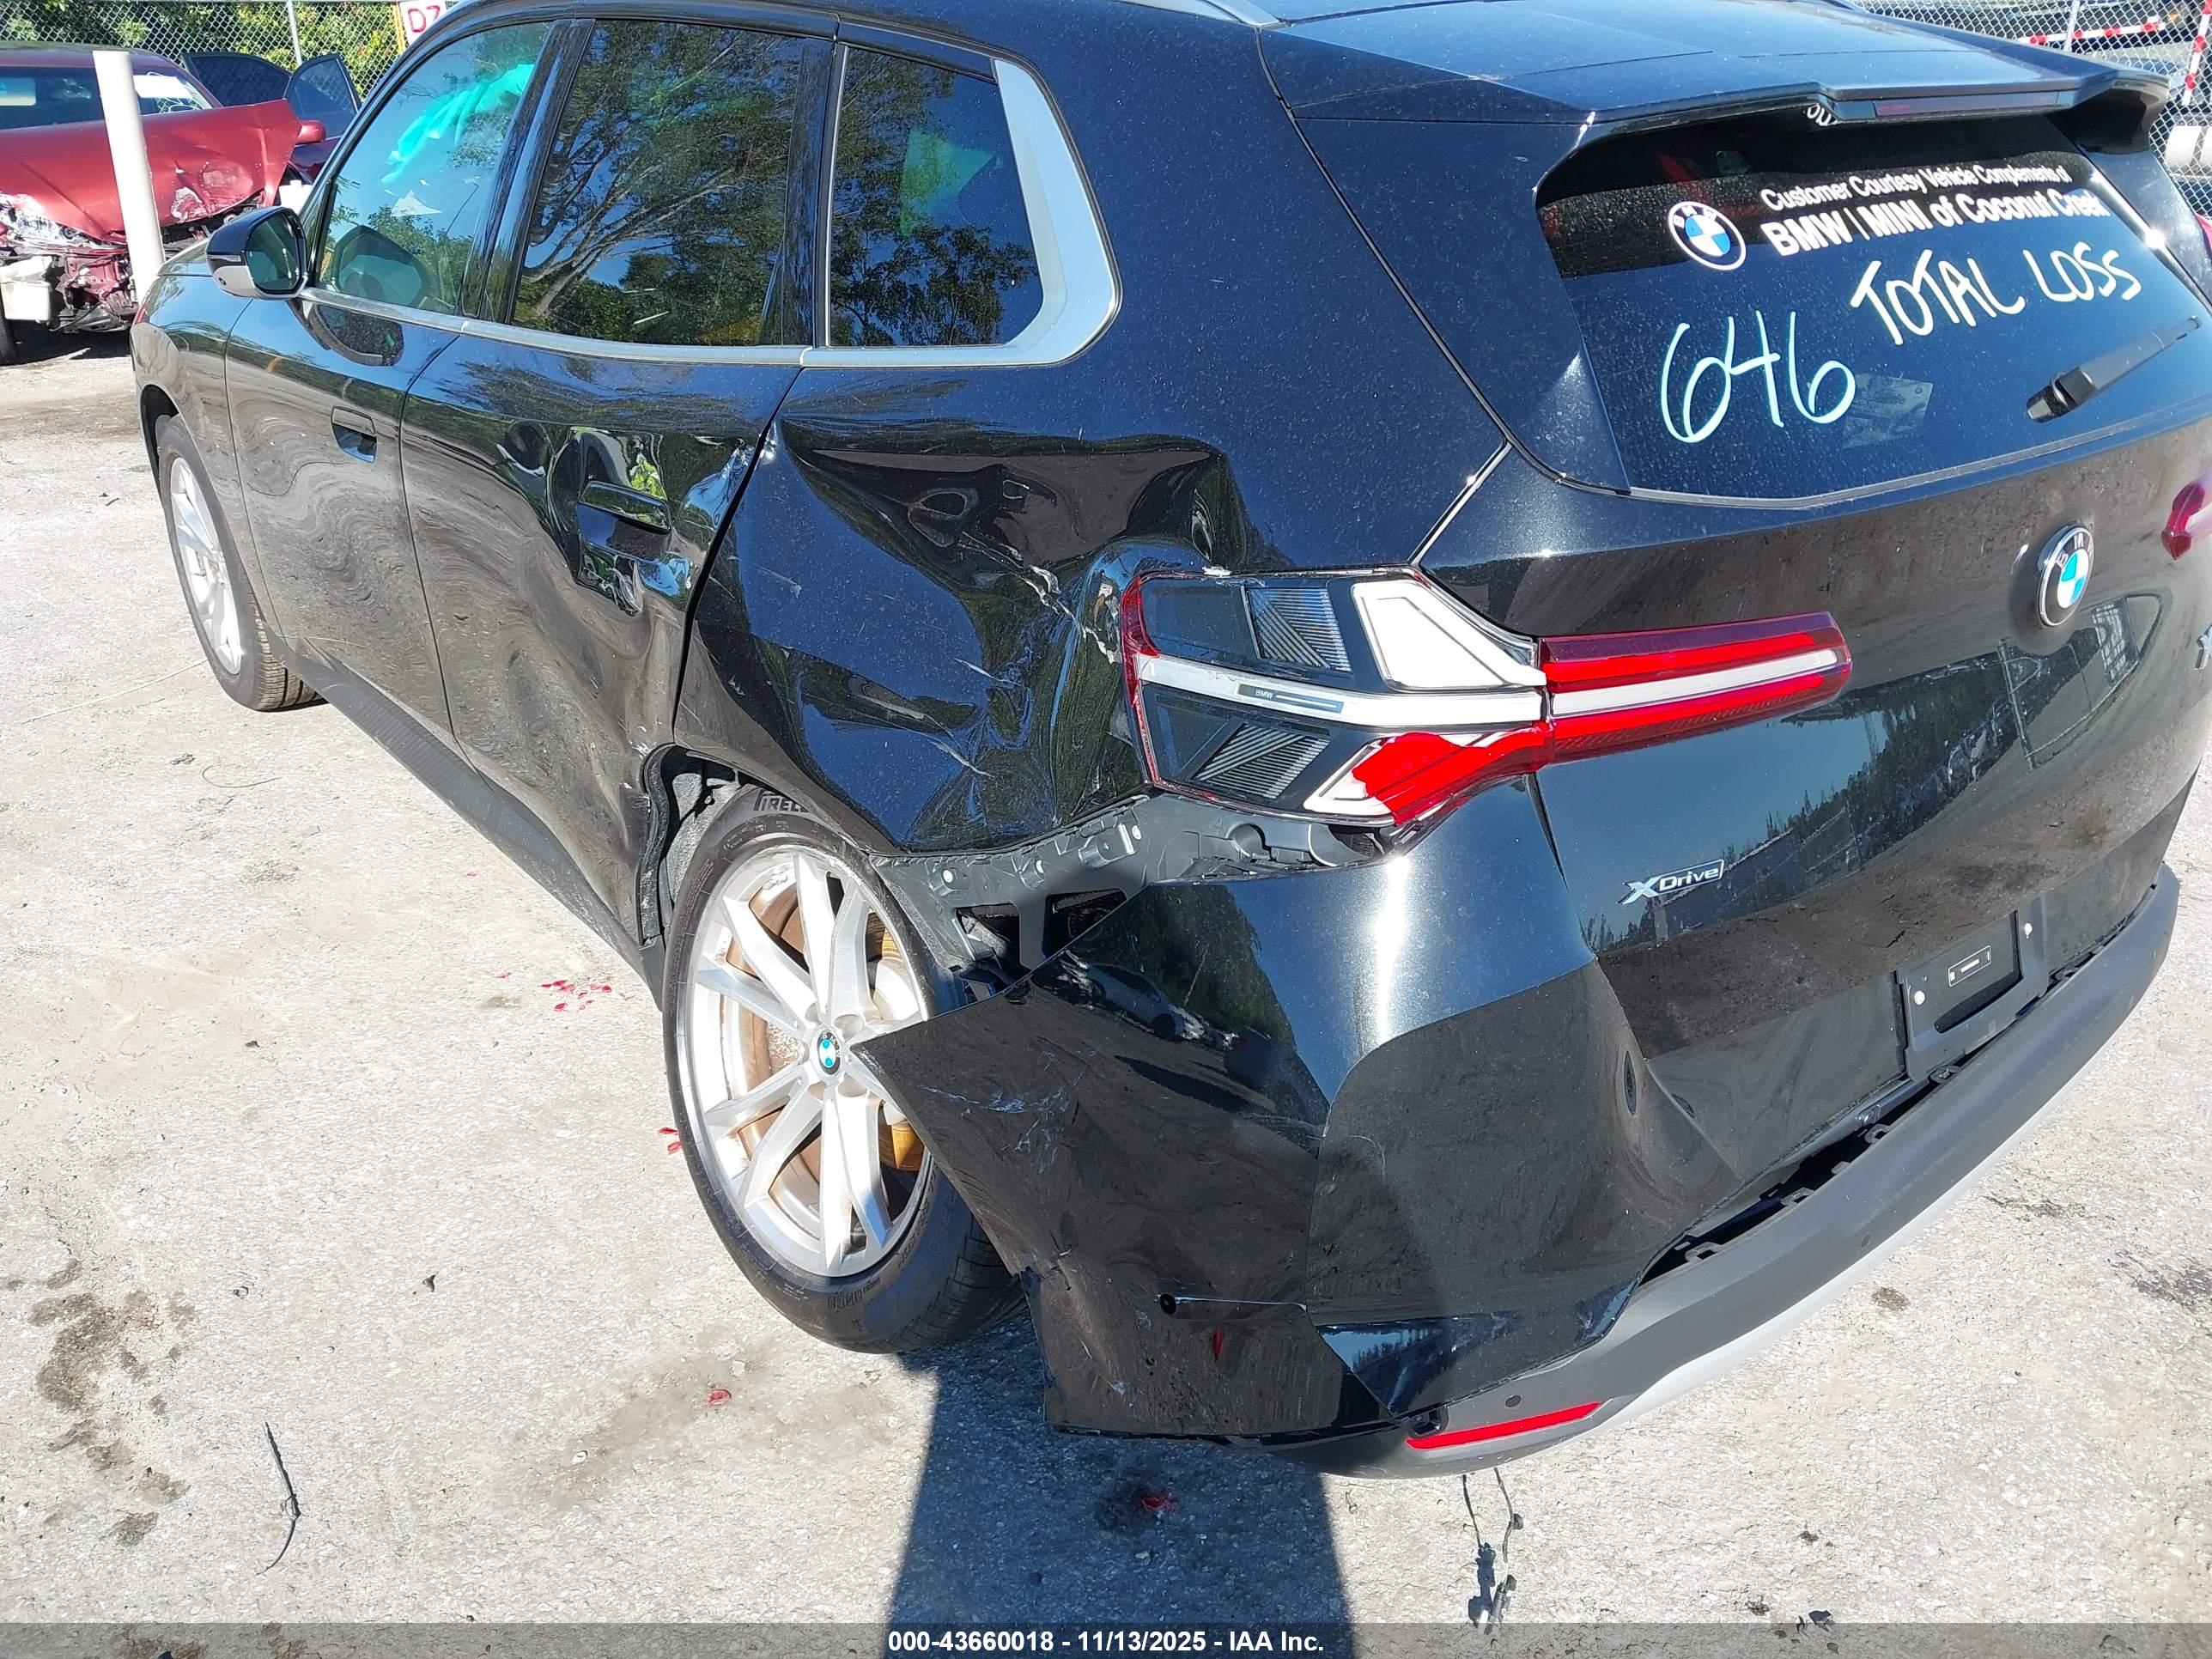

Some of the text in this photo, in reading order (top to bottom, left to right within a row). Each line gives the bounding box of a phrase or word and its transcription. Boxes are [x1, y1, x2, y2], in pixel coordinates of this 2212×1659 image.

[1760, 181, 1853, 211] Customer
[1849, 173, 1928, 194] Courtesy
[1917, 167, 1978, 188] Vehicle
[1760, 210, 1853, 256] BMW
[1856, 199, 1934, 237] MINI
[1929, 195, 1964, 227] of
[1955, 191, 2058, 223] Coconut
[1850, 241, 2142, 345] TOTAL LOSS
[1661, 310, 1856, 443] 646
